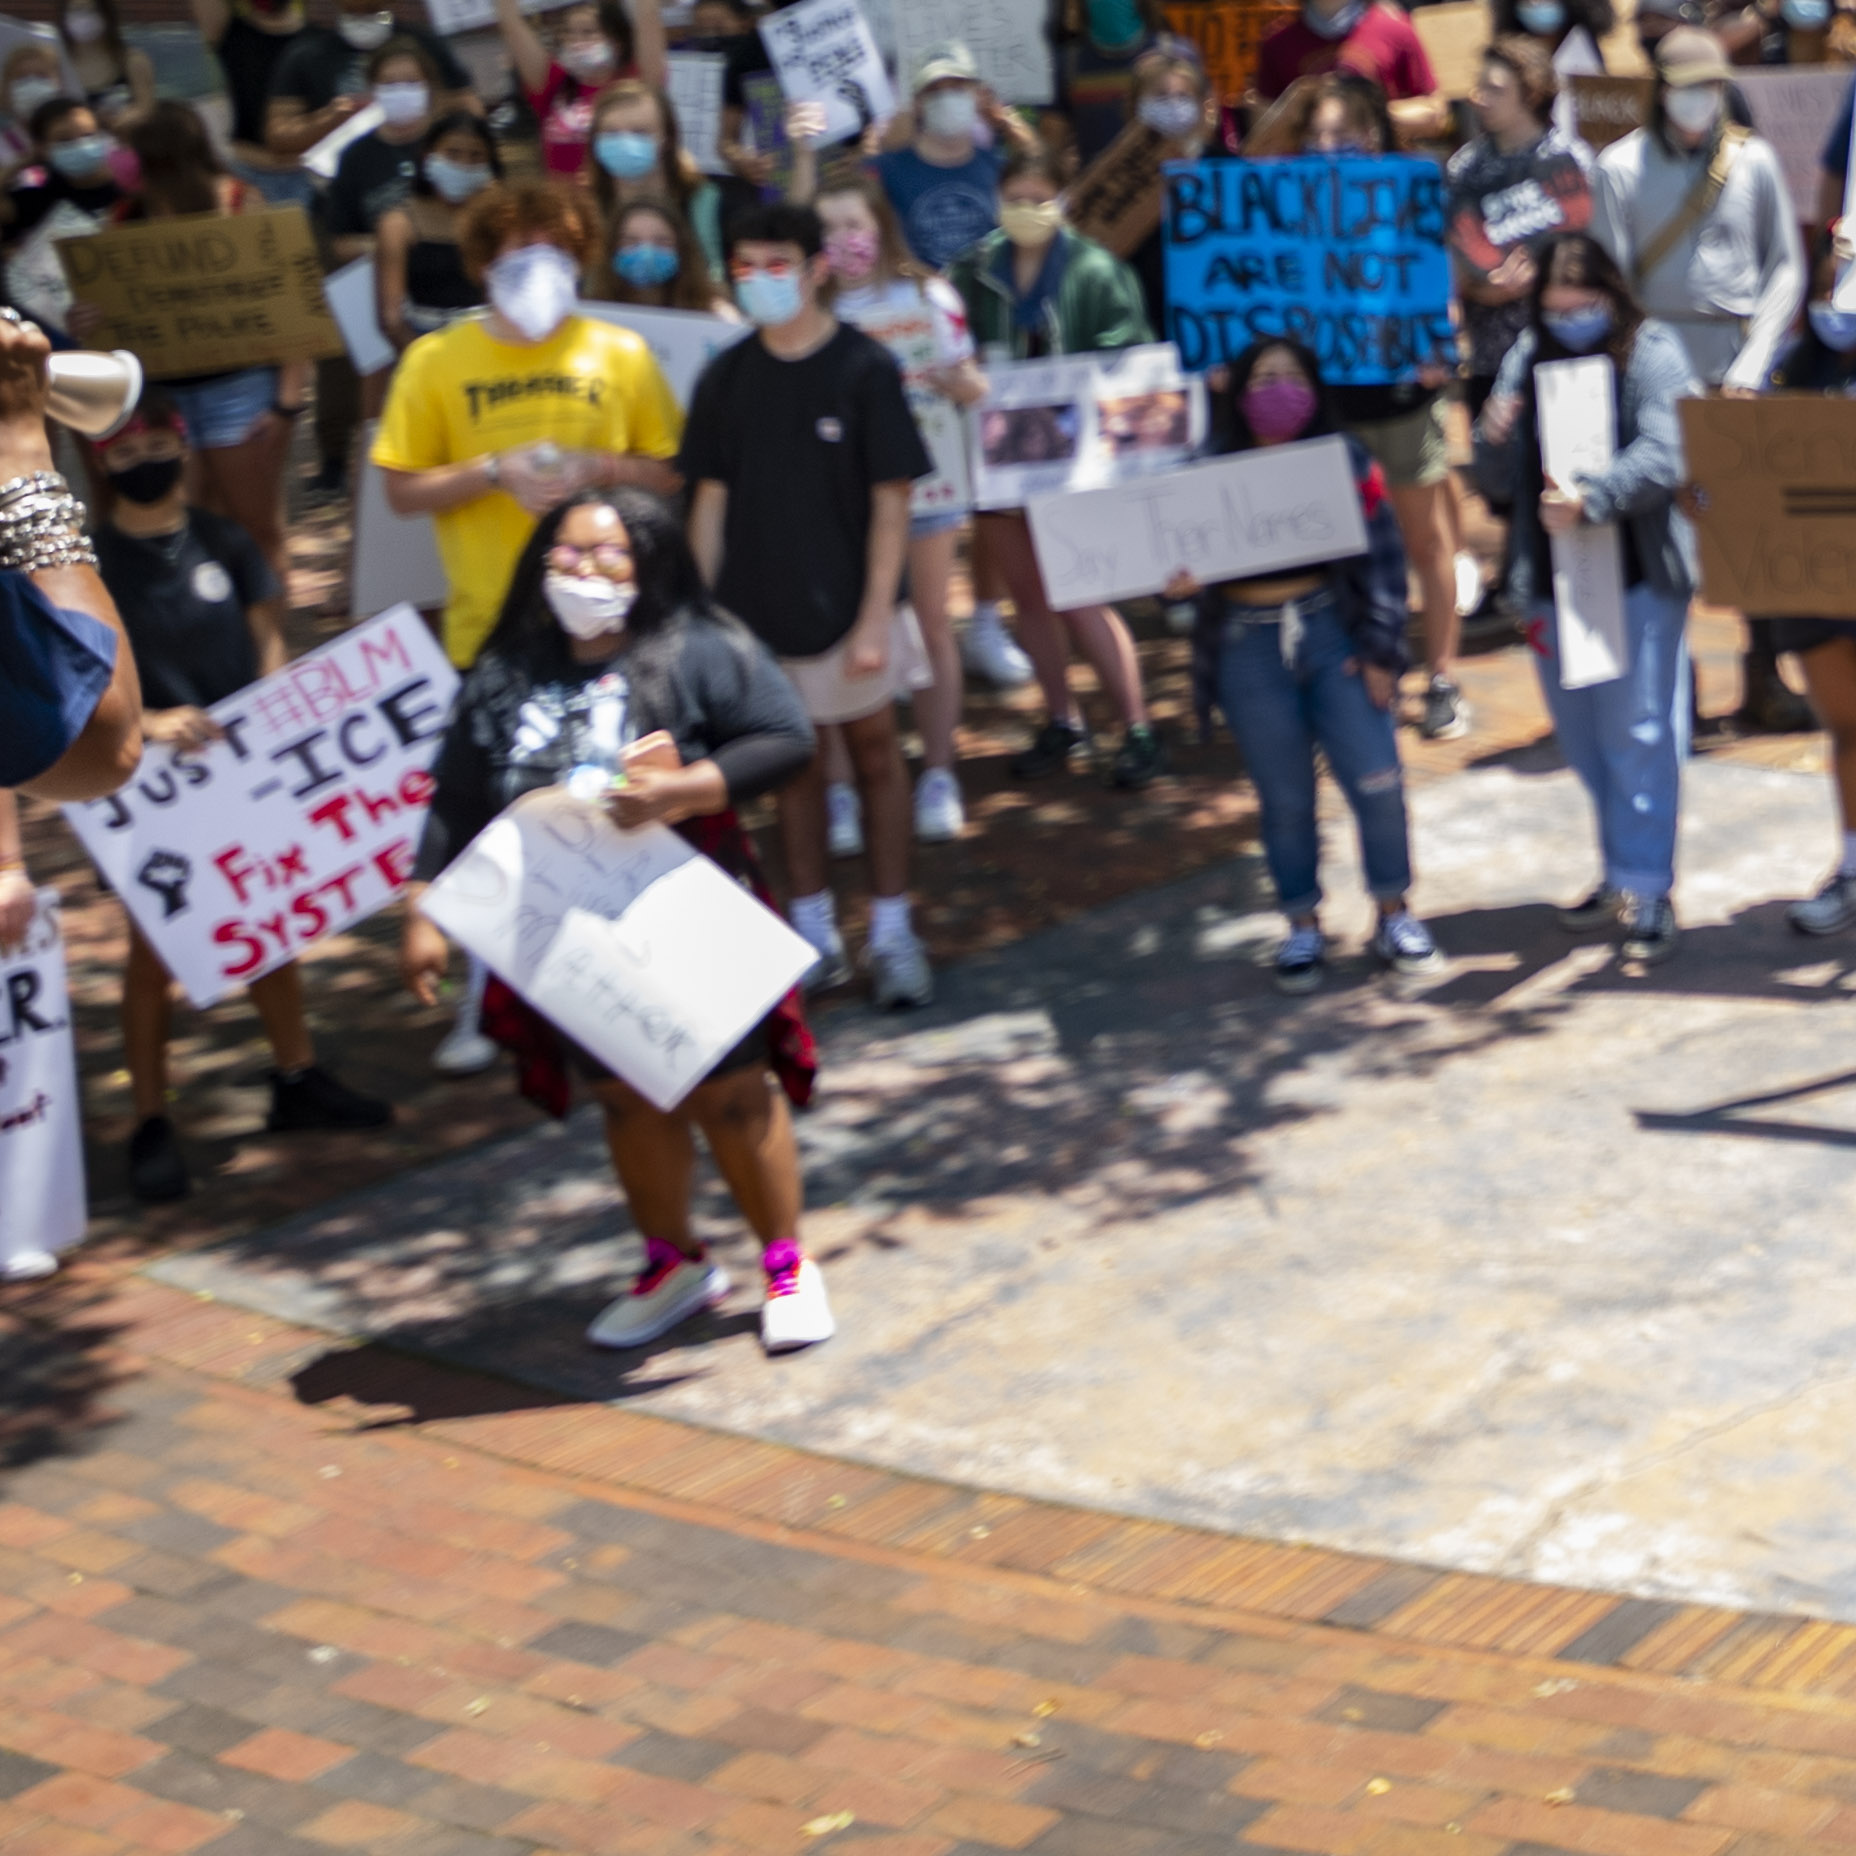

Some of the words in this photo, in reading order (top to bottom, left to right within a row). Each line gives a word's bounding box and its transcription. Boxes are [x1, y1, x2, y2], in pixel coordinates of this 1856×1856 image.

[1171, 166, 1326, 244] BLACK
[68, 227, 240, 286] DEFUND
[1202, 248, 1304, 293] ARE
[1321, 248, 1427, 293] NOT
[251, 624, 413, 738] #BLM
